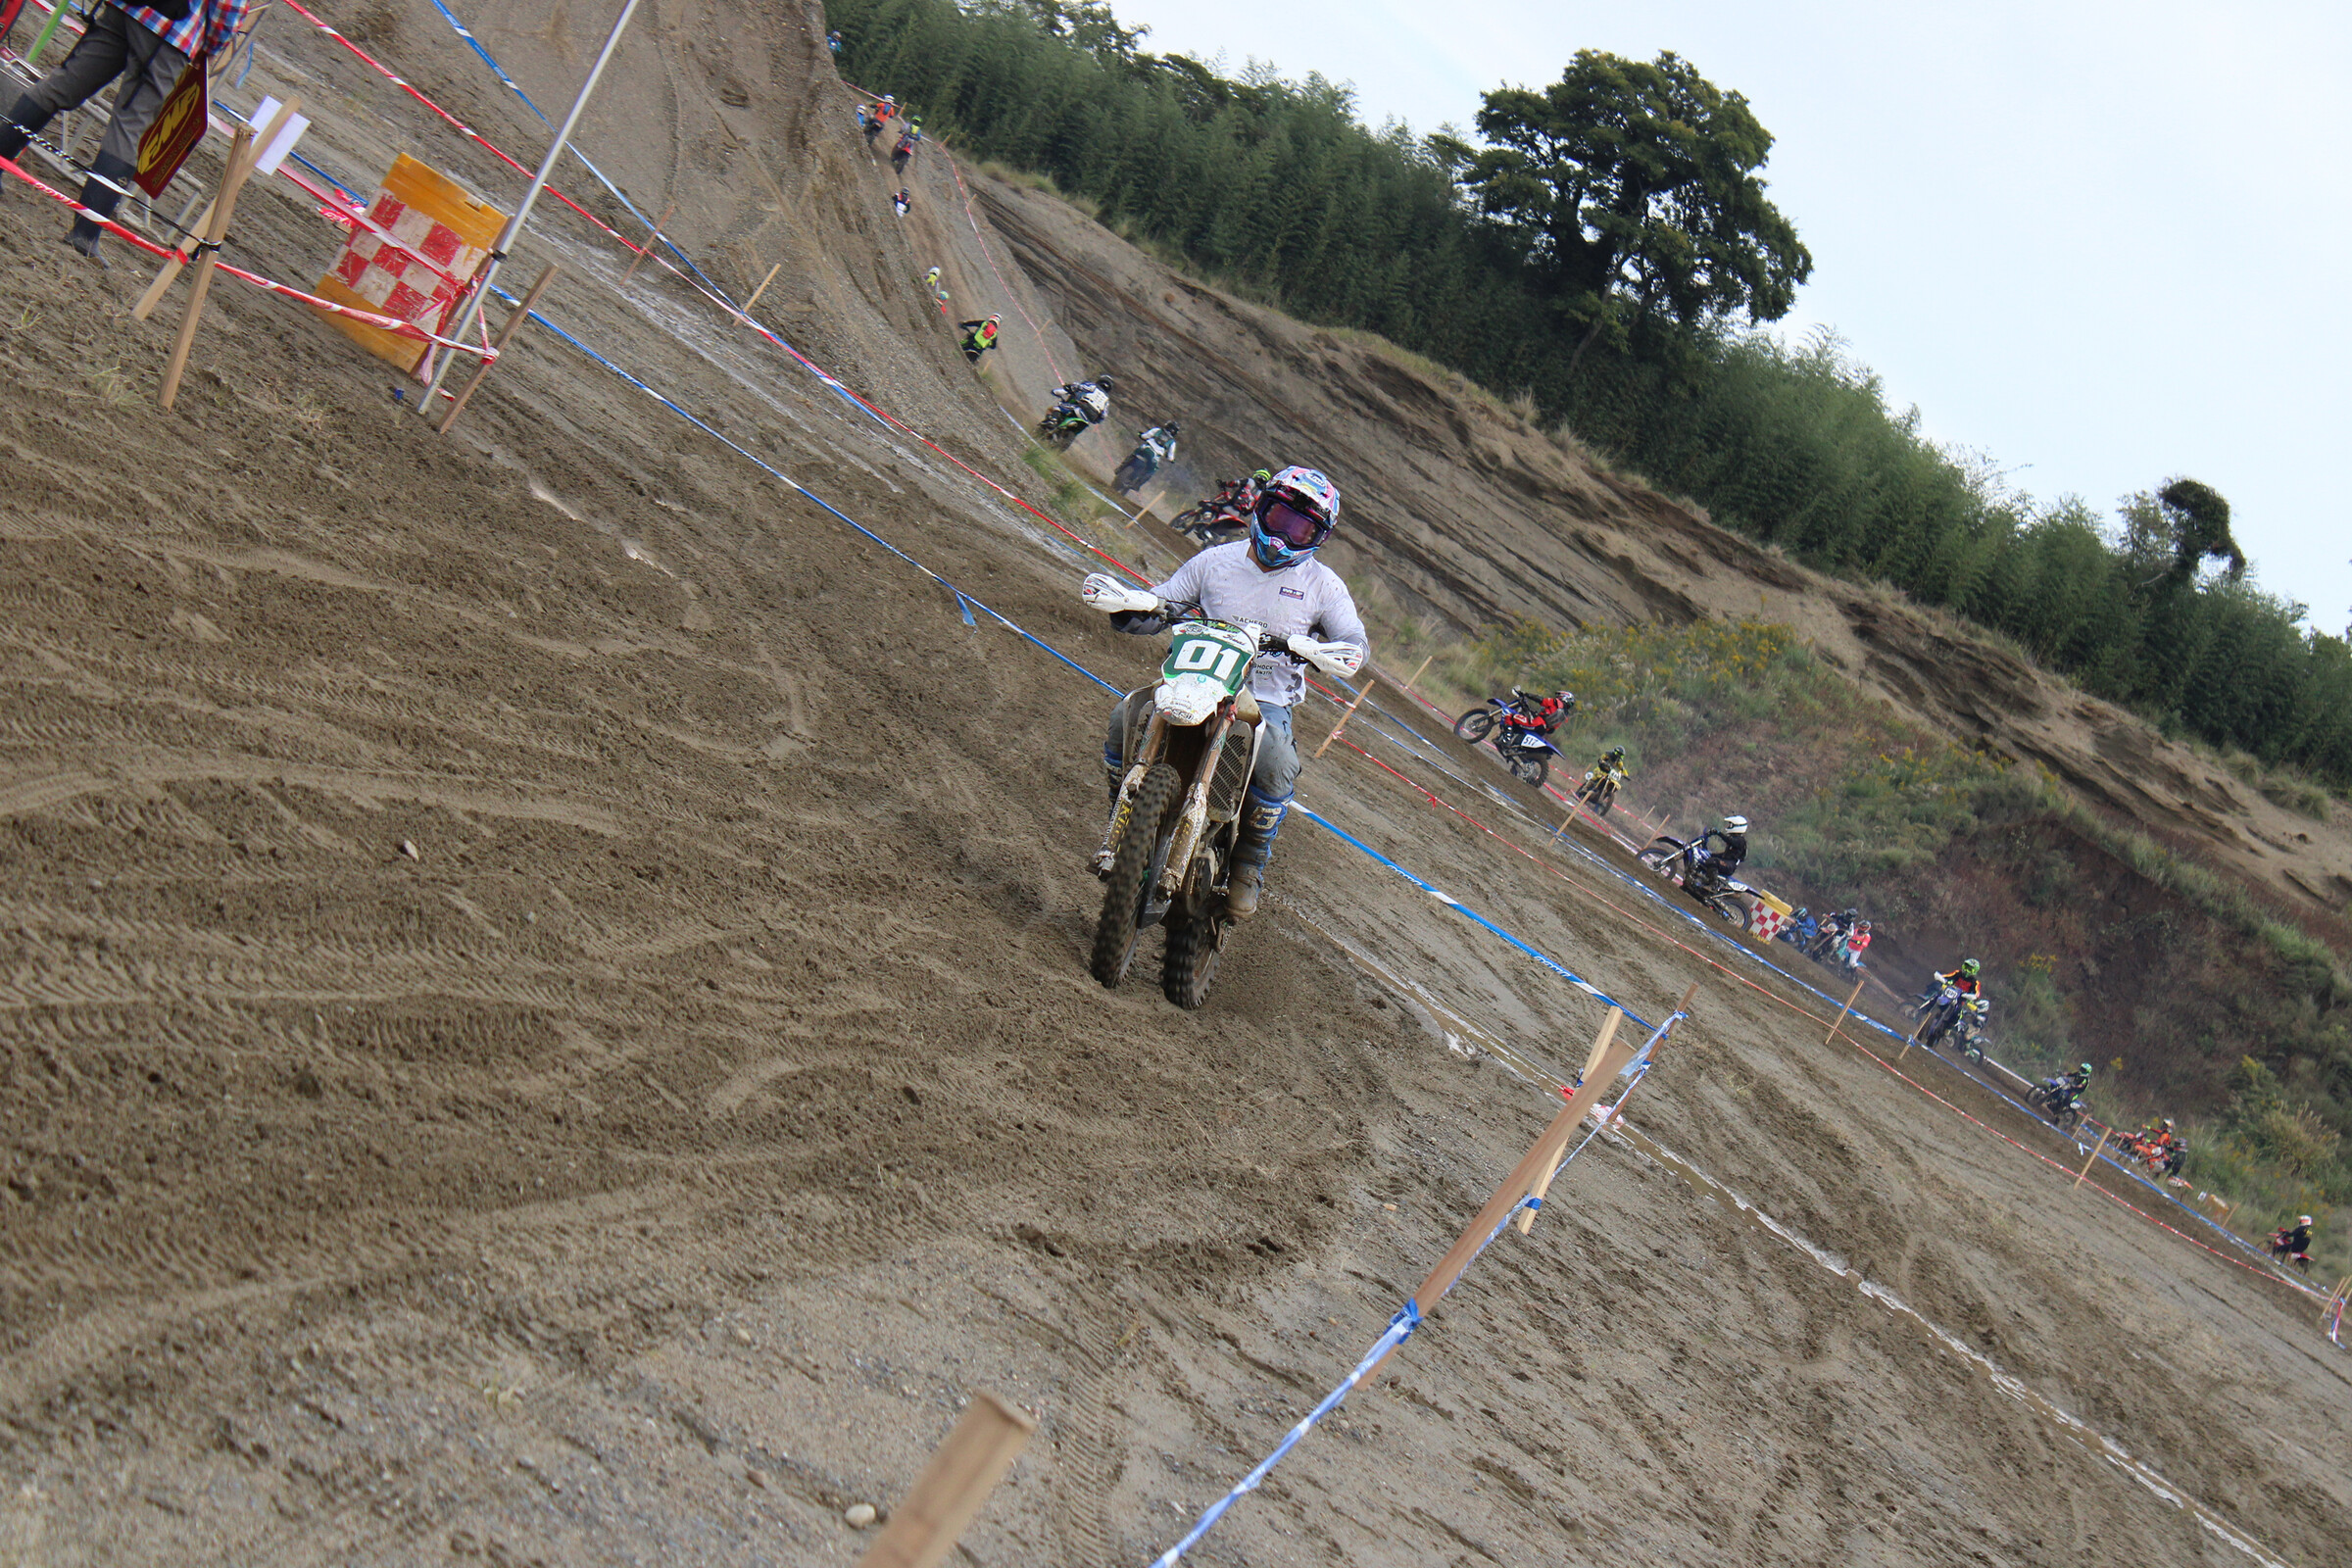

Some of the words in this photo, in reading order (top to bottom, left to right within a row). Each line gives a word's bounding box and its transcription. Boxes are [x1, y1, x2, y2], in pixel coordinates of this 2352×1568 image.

[139, 82, 199, 174] FMF
[1174, 639, 1241, 681] 01
[1523, 736, 1539, 746] 517
